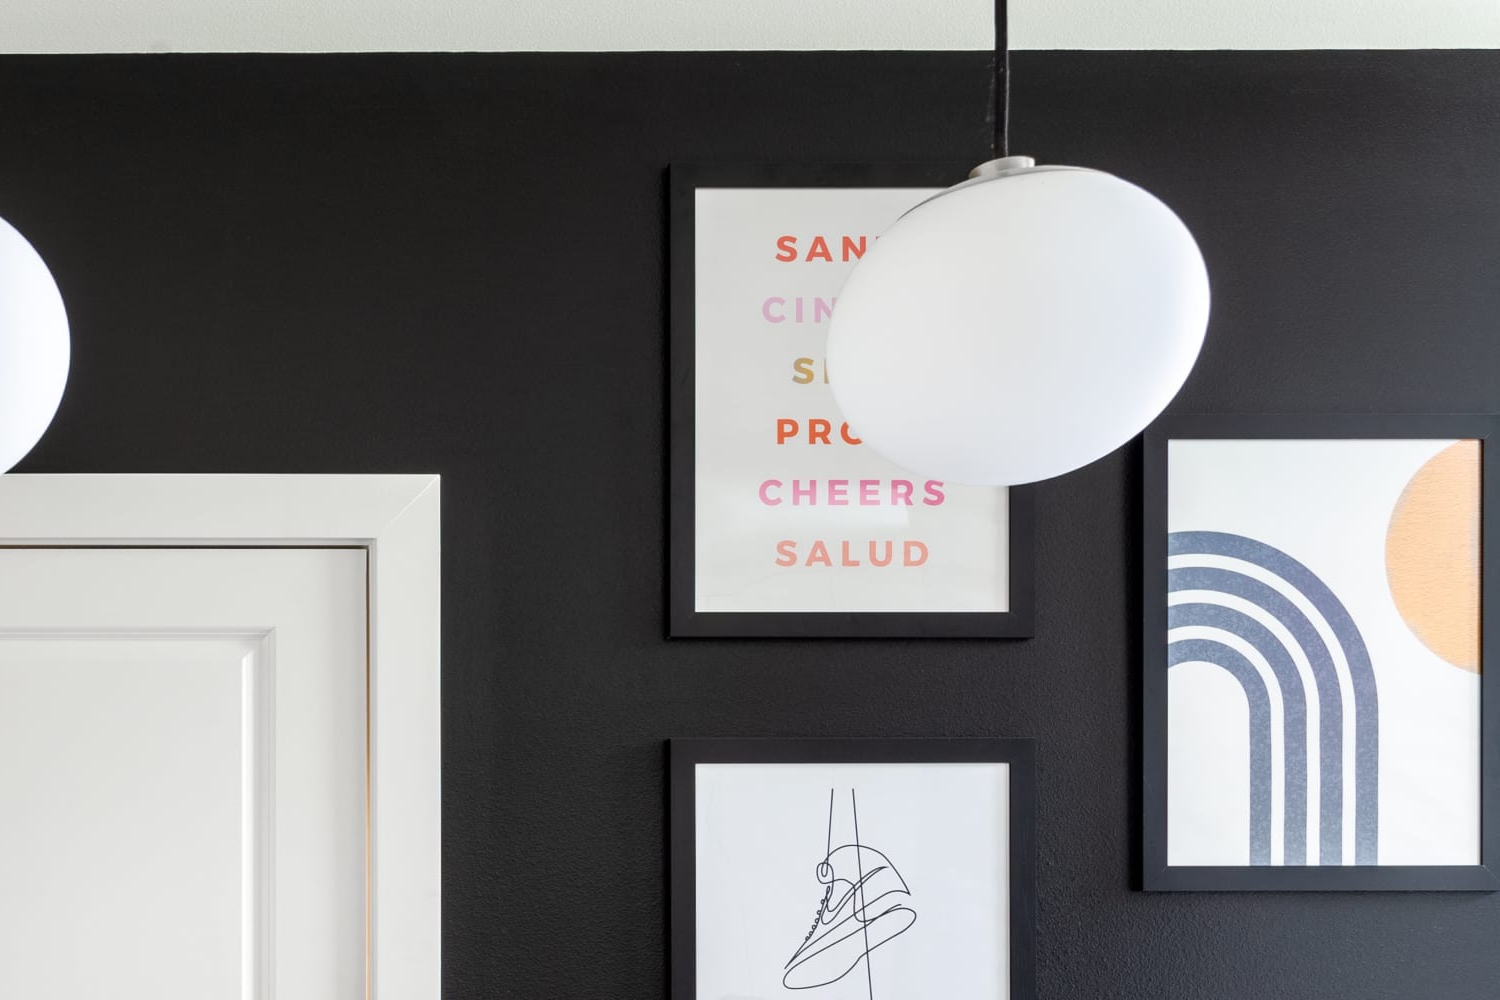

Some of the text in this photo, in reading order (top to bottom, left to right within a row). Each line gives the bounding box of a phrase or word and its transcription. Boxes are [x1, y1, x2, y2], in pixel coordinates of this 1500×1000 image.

[776, 235, 881, 262] SAN
[758, 479, 945, 506] CHEERS
[775, 540, 929, 567] SALUD
